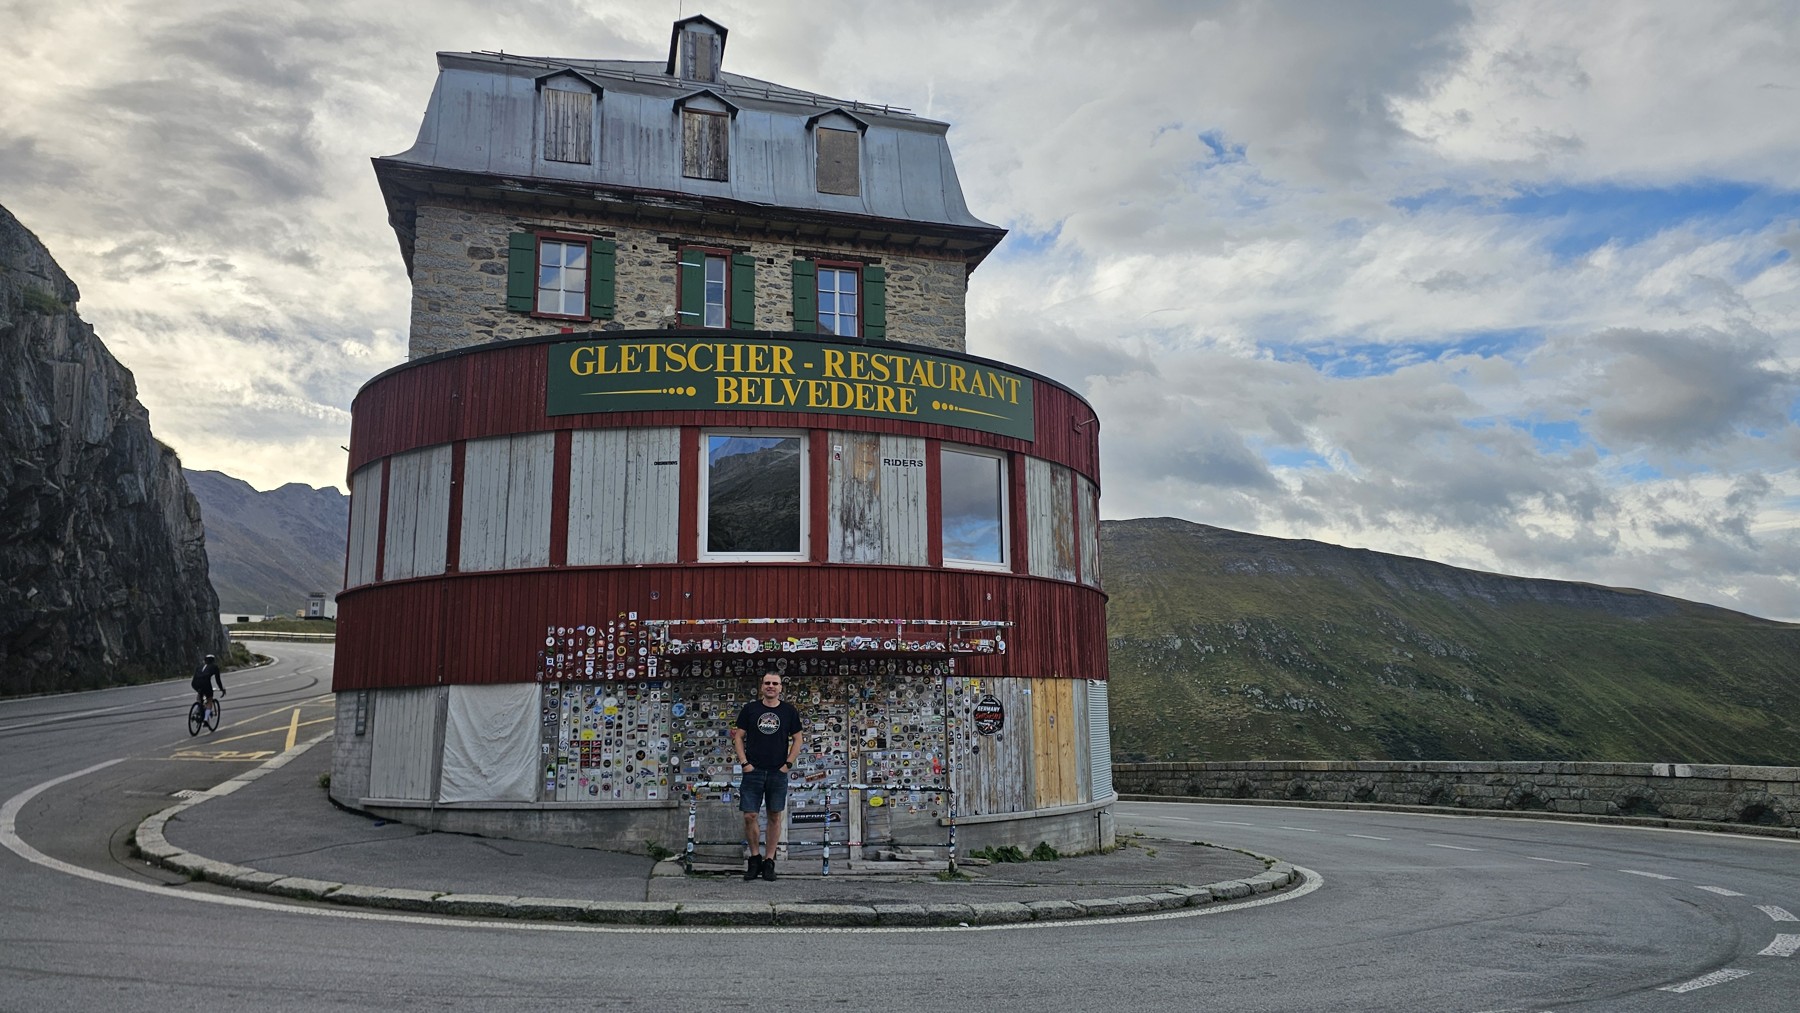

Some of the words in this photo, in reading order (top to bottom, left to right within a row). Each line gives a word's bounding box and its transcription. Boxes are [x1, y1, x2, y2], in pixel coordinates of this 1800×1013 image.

[570, 343, 795, 375] GLETSCHER
[823, 349, 1022, 405] RESTAURANT
[716, 377, 918, 415] BELVEDERE
[883, 458, 924, 468] RIDERS
